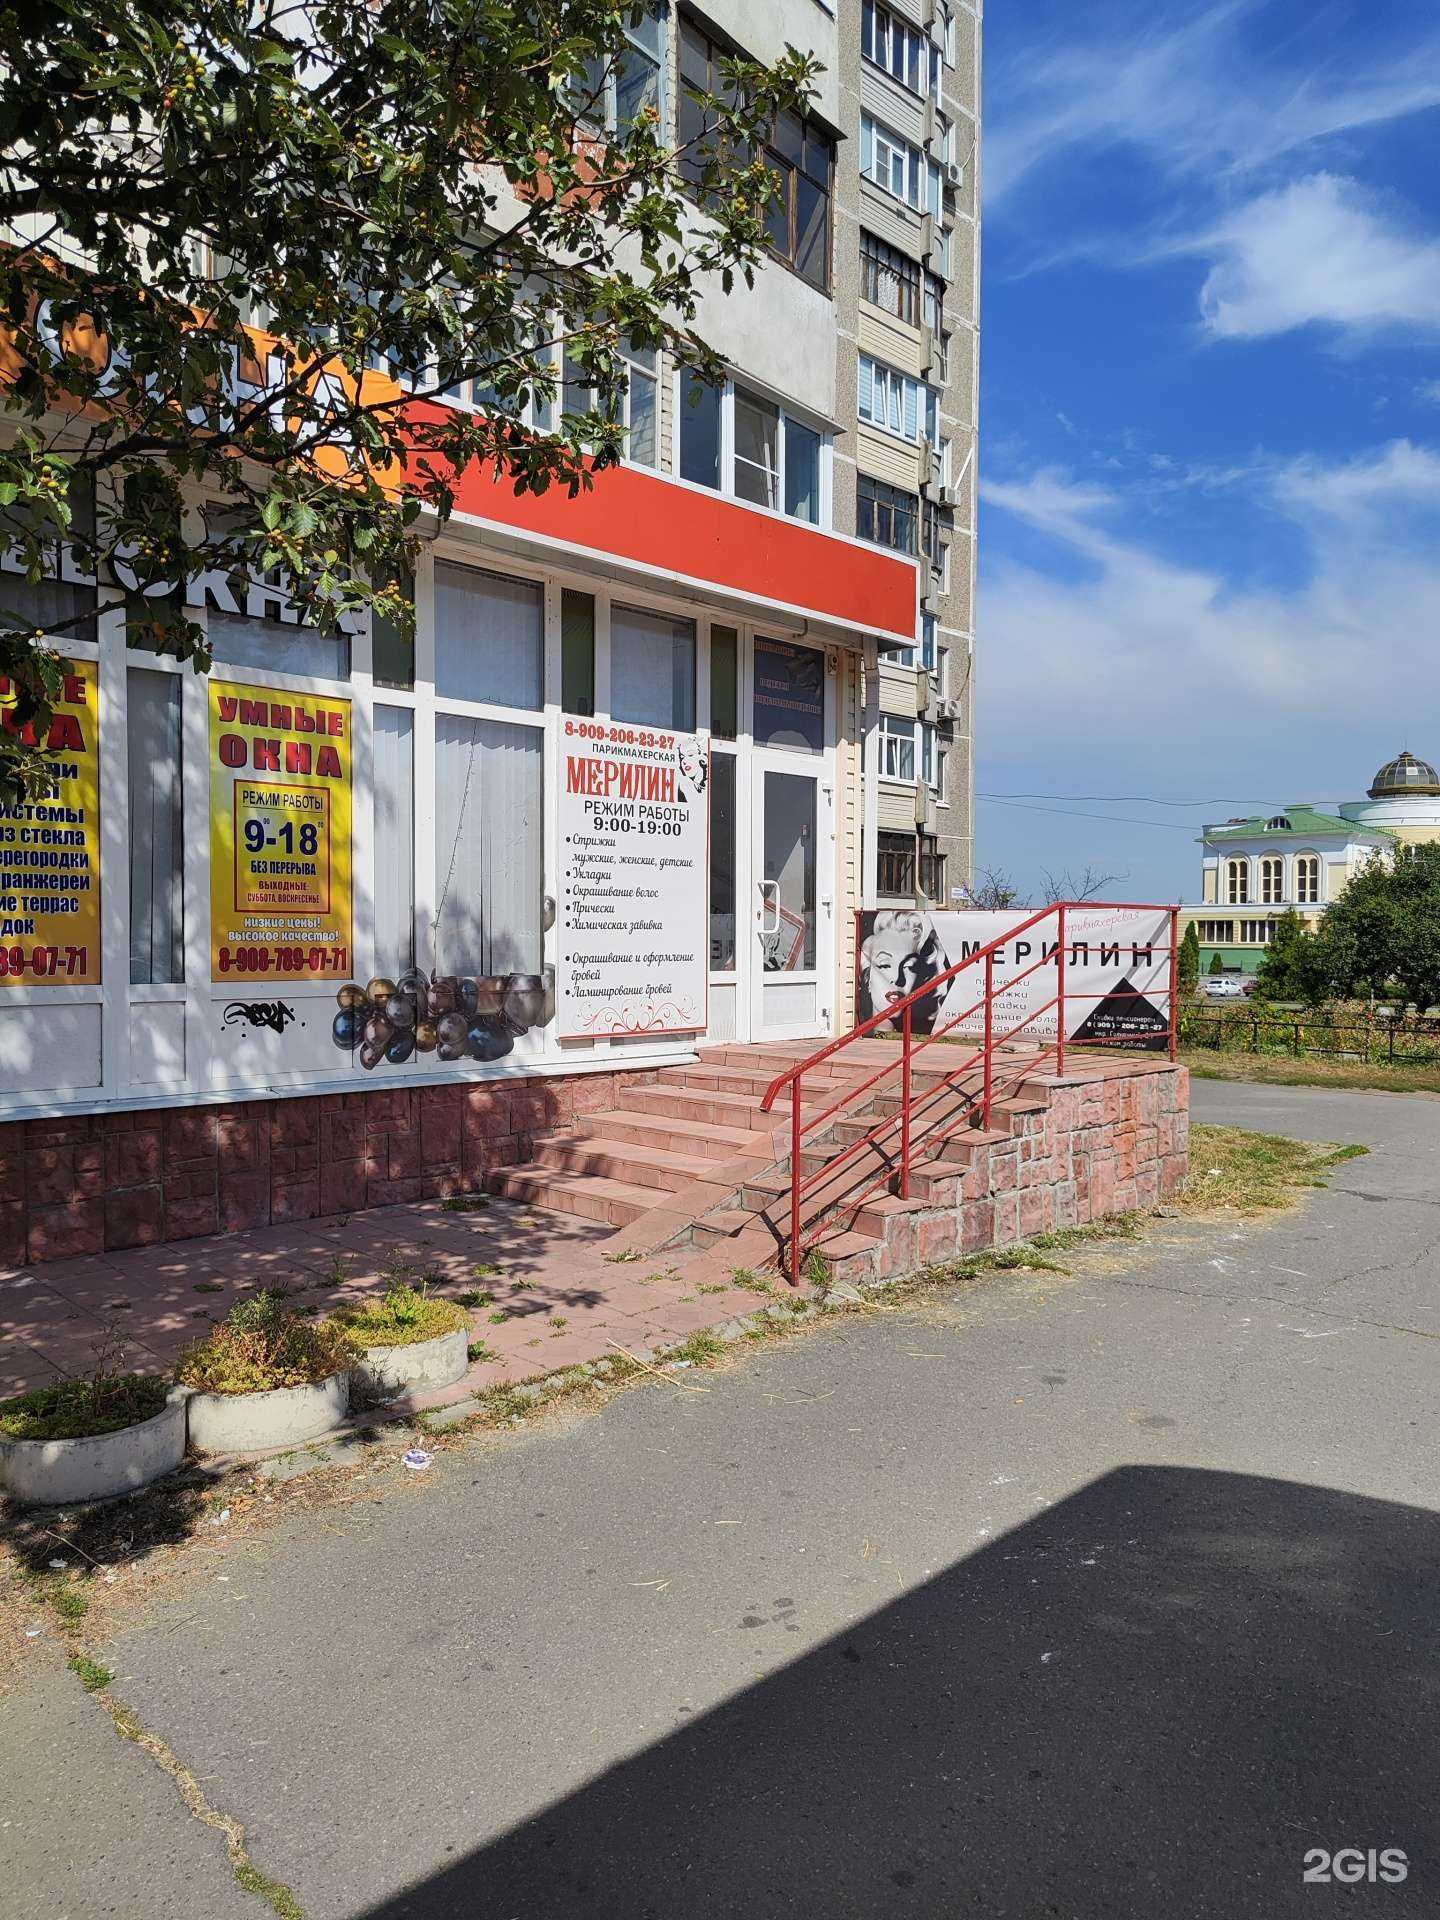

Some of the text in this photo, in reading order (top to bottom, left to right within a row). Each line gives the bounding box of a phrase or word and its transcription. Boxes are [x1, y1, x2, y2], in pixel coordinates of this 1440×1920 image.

[217, 696, 343, 737] УМНЫЕ
[219, 734, 343, 778] ОКНА
[592, 743, 676, 763] ПАРИКМАХЕРСКАЯ
[566, 756, 676, 804] МЕРИЛИН
[242, 790, 324, 810] РЕЖИМ РАБОТЫ
[584, 800, 690, 822] РЕЖИМ РАБОТЫ
[593, 816, 682, 837] 9:00-19:00
[21, 827, 86, 846] стекла
[572, 833, 617, 851] Стрижки
[251, 860, 317, 876] БЕЗ ПЕРЕРЫВА
[571, 853, 694, 871] мужские, женские, детские
[572, 867, 612, 884] Укладки
[278, 894, 320, 904] ВОСКРЕСЕНЬЕ
[572, 884, 660, 901] Окрашивание волос
[21, 896, 79, 914] террас
[572, 901, 615, 918] Прически
[287, 918, 321, 928] цены!
[571, 917, 663, 935] Химическая завивка
[282, 931, 340, 941] качество!
[218, 946, 347, 972] 8-908-789-07-71
[572, 951, 694, 968] Окрашивание и оформление
[961, 940, 1152, 968] МЕРИЛИН
[570, 968, 601, 986] бровей
[571, 983, 672, 1001] Ламинирование бровей
